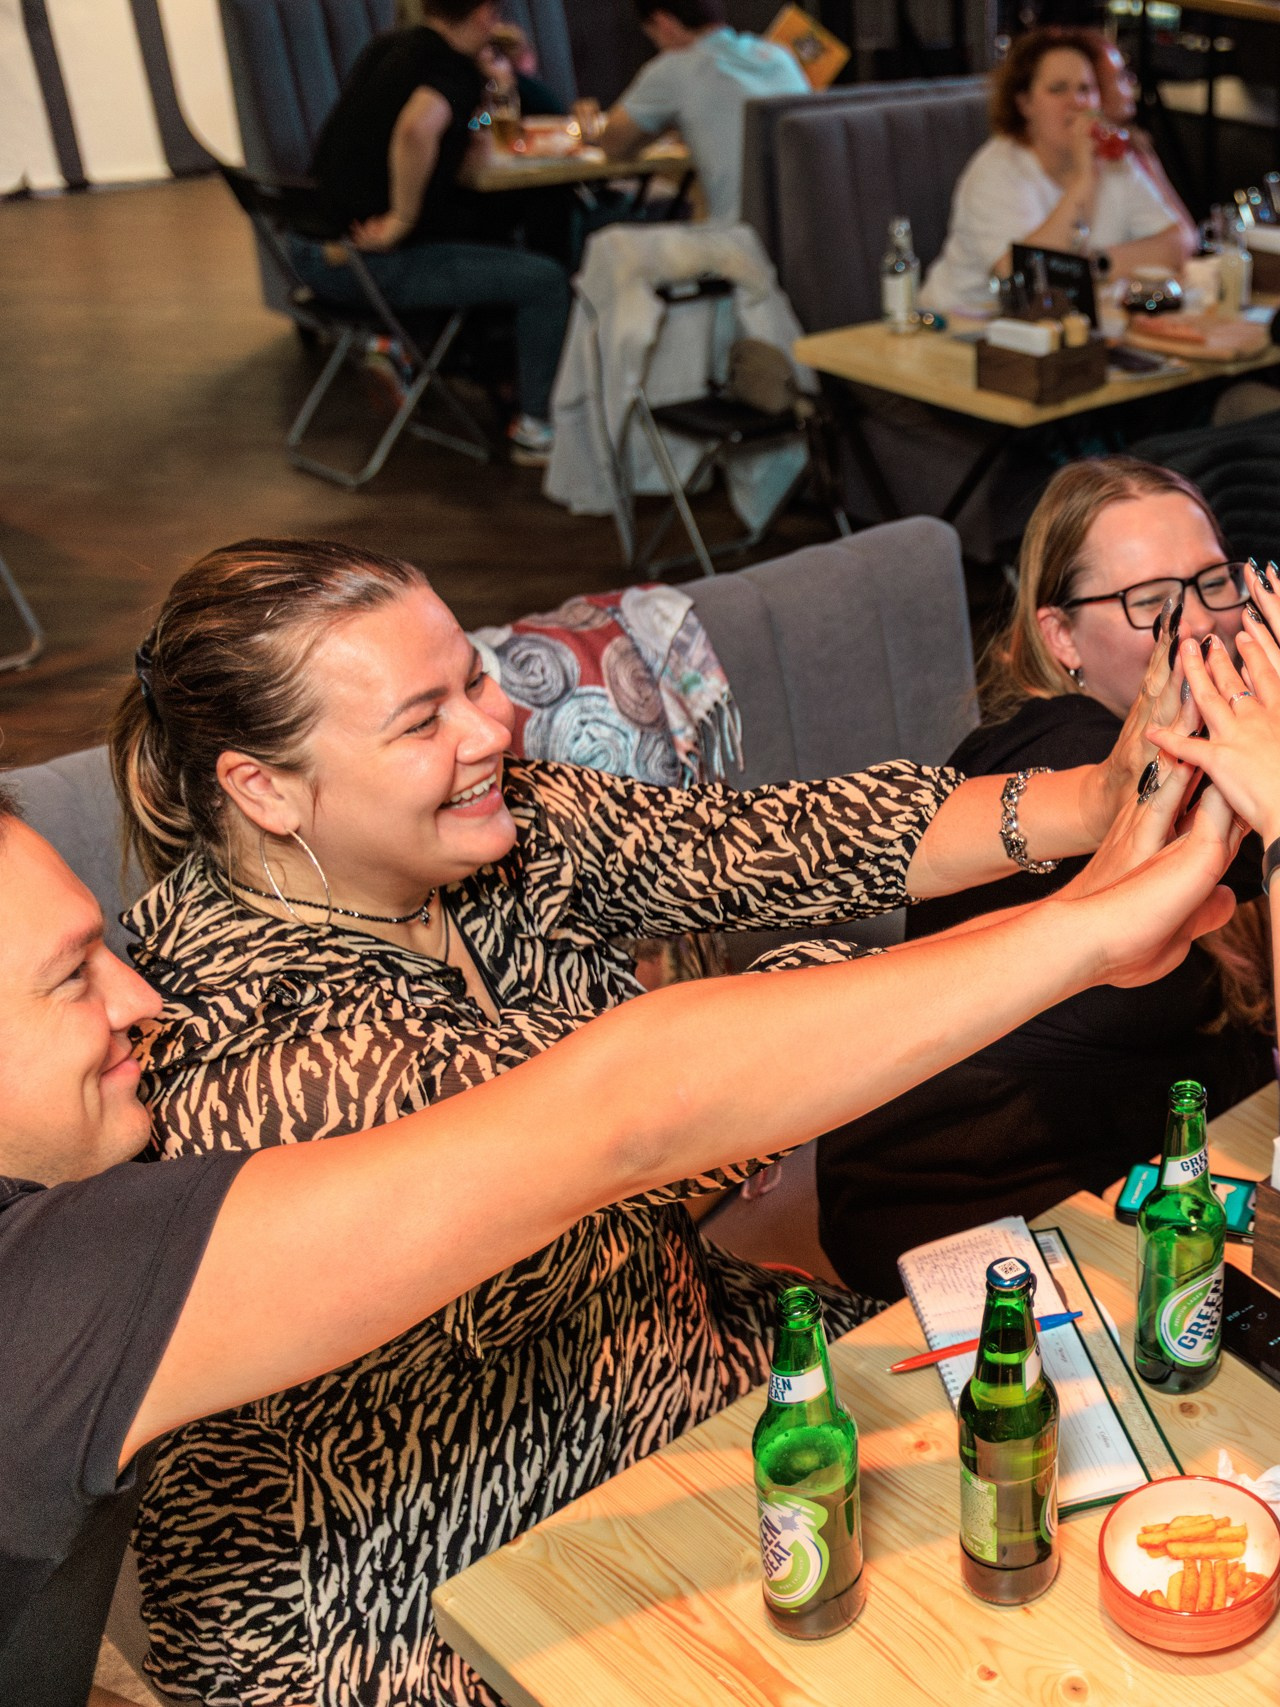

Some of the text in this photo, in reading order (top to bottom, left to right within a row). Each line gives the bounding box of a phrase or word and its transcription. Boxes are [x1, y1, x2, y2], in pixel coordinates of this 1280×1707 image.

[1177, 1278, 1223, 1350] GREEN
[768, 1387, 786, 1401] EAT
[770, 1374, 793, 1391] EEN
[760, 1515, 782, 1553] EEN
[762, 1541, 792, 1579] BEAT
